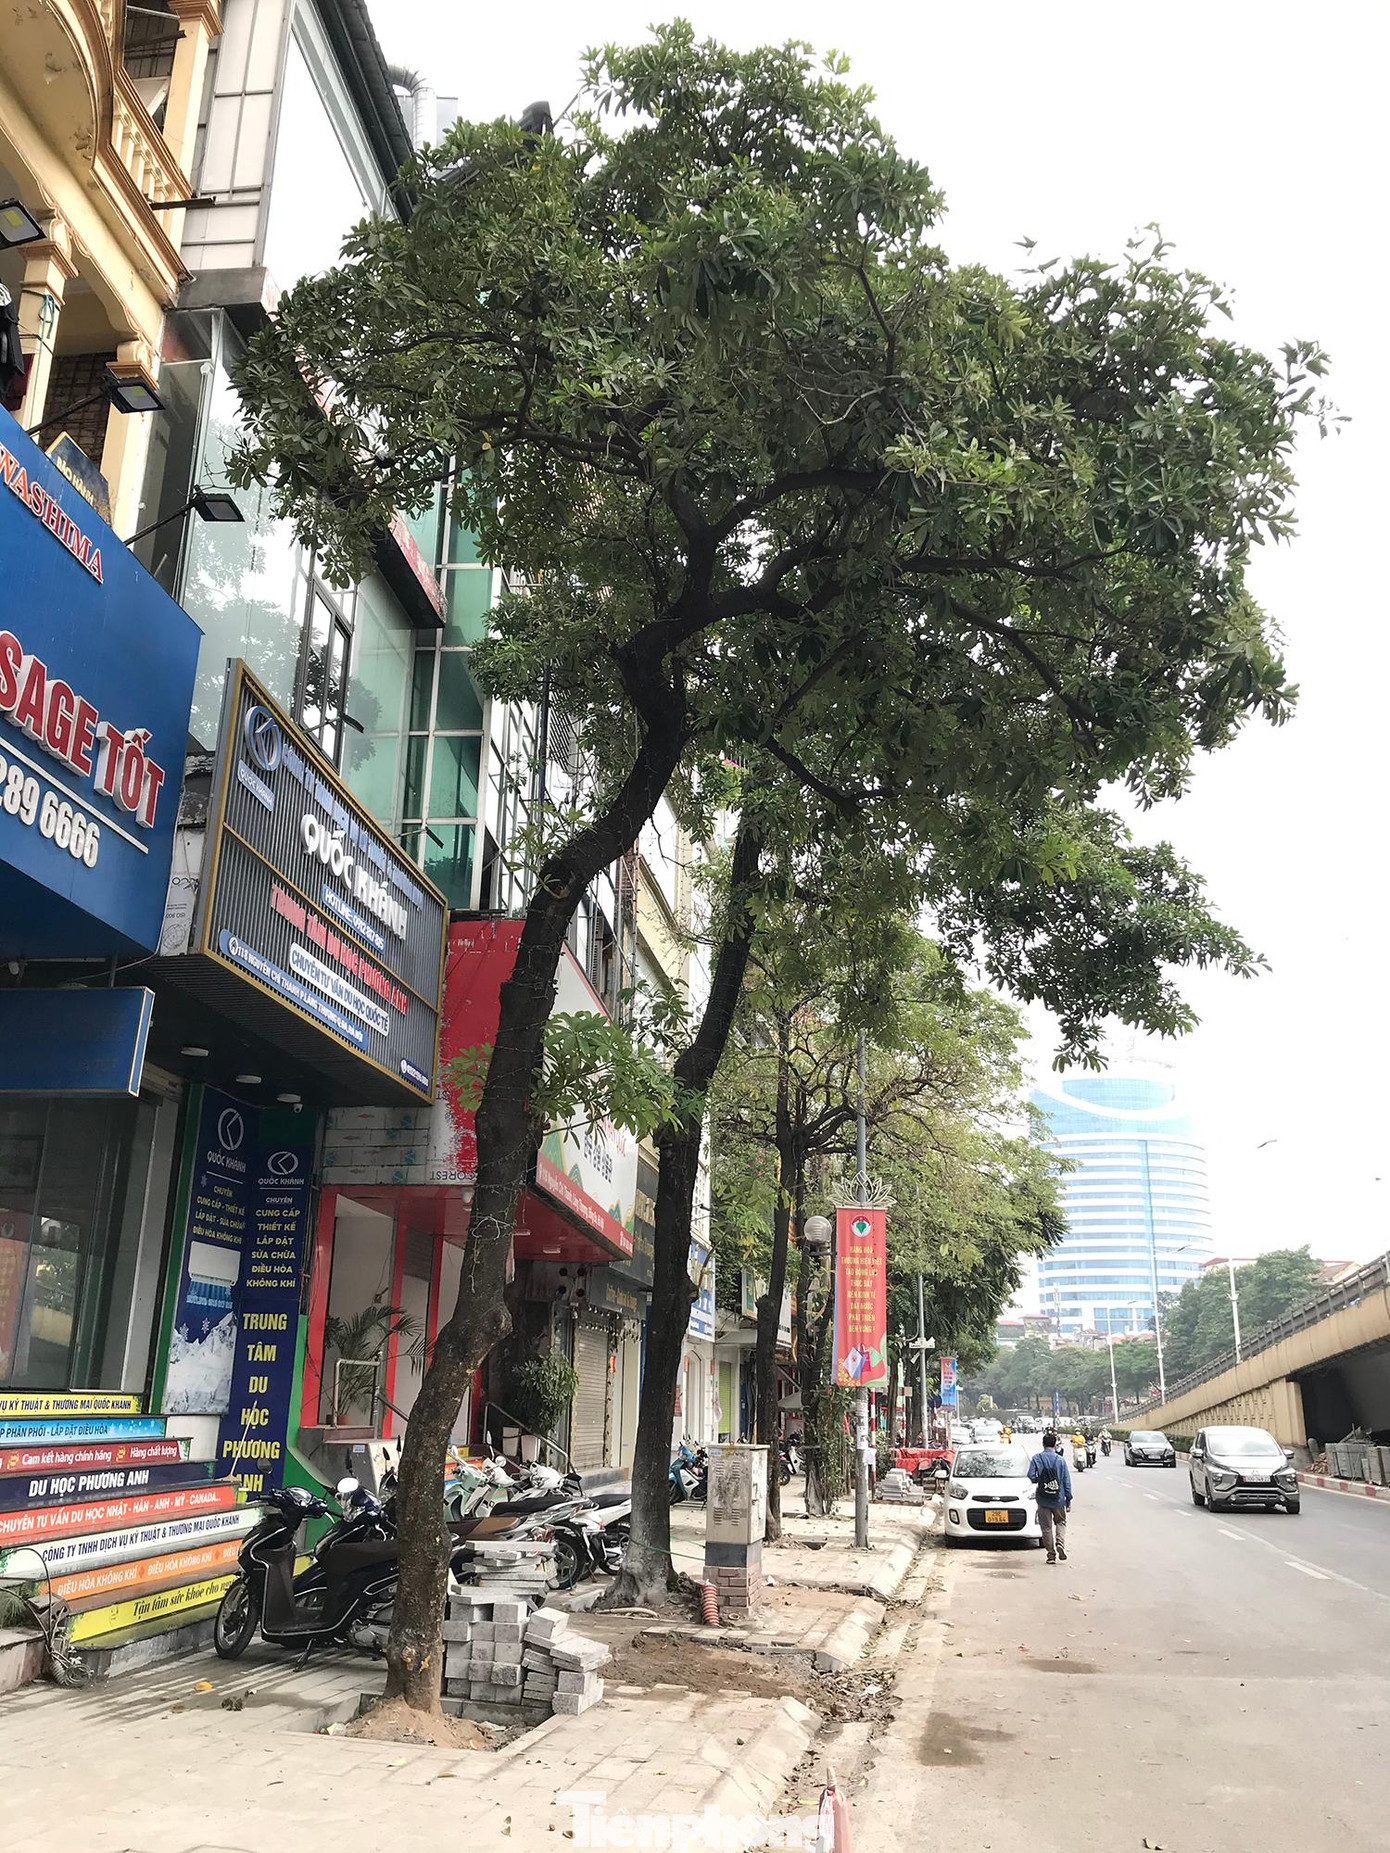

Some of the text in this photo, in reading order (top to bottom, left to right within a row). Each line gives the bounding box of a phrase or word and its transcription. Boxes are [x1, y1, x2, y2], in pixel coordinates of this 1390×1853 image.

[94, 721, 166, 829] TỐT
[40, 790, 100, 868] 6666
[301, 813, 354, 890] QUỐC
[353, 865, 408, 940] KHÁNH
[271, 882, 306, 933] TRUNG
[306, 912, 327, 950] TÂM
[327, 930, 341, 960] DU
[340, 942, 359, 977] HỌC
[359, 957, 391, 1003] PHƯƠNG
[391, 985, 408, 1016] ANH
[292, 949, 319, 983] CHUYÊN
[320, 970, 331, 989] TƯ
[331, 977, 343, 1000] VẤN
[343, 988, 352, 1007] DU
[352, 996, 365, 1016] HỌC
[365, 1004, 380, 1026] QUỐC
[380, 1015, 389, 1033] TẾ
[207, 1150, 225, 1167] QUỐC
[258, 1176, 279, 1186] QUỐC
[255, 1206, 301, 1218] CUNG CẤP
[256, 1220, 298, 1231] THIẾT KẾ
[256, 1234, 295, 1247] LẮP ĐẶT
[251, 1248, 296, 1259] SỬA CHỮA
[251, 1262, 293, 1273] ĐIỀU HÒA
[246, 1277, 297, 1288] KHÔNG KHÍ
[242, 1312, 288, 1331] TRUNG
[247, 1341, 278, 1362] TÂM
[248, 1376, 269, 1394] DU
[20, 1397, 44, 1413] THUẬT
[44, 1400, 50, 1410] &
[52, 1398, 79, 1410] THƯƠNG
[79, 1399, 93, 1412] MẠI
[93, 1396, 110, 1410] QUỐC
[240, 1408, 270, 1430] HỌC
[5, 1424, 27, 1438] PHÂN
[27, 1423, 47, 1437] PHỐI
[50, 1422, 64, 1437] LẮP
[64, 1423, 78, 1439] ĐẶT
[78, 1422, 94, 1436] ĐIỀU
[94, 1422, 108, 1435] HÒA
[22, 1453, 40, 1465] Cam
[40, 1450, 55, 1464] kết
[54, 1450, 74, 1464] hàng
[74, 1449, 95, 1462] chính
[130, 1446, 147, 1460] Hàng
[147, 1443, 161, 1457] chất
[161, 1445, 178, 1458] lượng
[222, 1439, 281, 1459] PHƯƠNG
[28, 1469, 150, 1498] DU HỌC PHƯƠNG ANH
[36, 1512, 49, 1529] TƯ
[50, 1506, 70, 1527] VẤN
[70, 1511, 84, 1523] DU
[85, 1509, 105, 1527] HỌC
[106, 1502, 128, 1519] NHẬT
[132, 1498, 150, 1513] HÀN
[153, 1497, 170, 1510] ANH
[174, 1493, 185, 1507] MỸ
[43, 1546, 65, 1562] CÔNG
[67, 1544, 77, 1558] TY
[78, 1541, 98, 1556] TNHH
[100, 1537, 114, 1554] DỊCH
[114, 1534, 129, 1550] VỤ
[140, 1527, 161, 1544] THUẬT
[161, 1529, 167, 1538] &
[168, 1522, 193, 1537] THƯƠNG
[193, 1519, 205, 1533] MẠI
[205, 1514, 221, 1530] QUỐC
[57, 1581, 78, 1597] ĐIỀU
[78, 1577, 96, 1591] HÒA
[96, 1570, 124, 1588] KHÔNG
[124, 1564, 139, 1580] KHÍ
[147, 1561, 165, 1576] ĐIỀU
[165, 1557, 179, 1571] HÒA
[179, 1551, 201, 1568] KHÔNG
[133, 1600, 151, 1620] Tận
[151, 1595, 169, 1611] tâm
[170, 1589, 185, 1605] sức
[205, 1581, 220, 1596] cho
